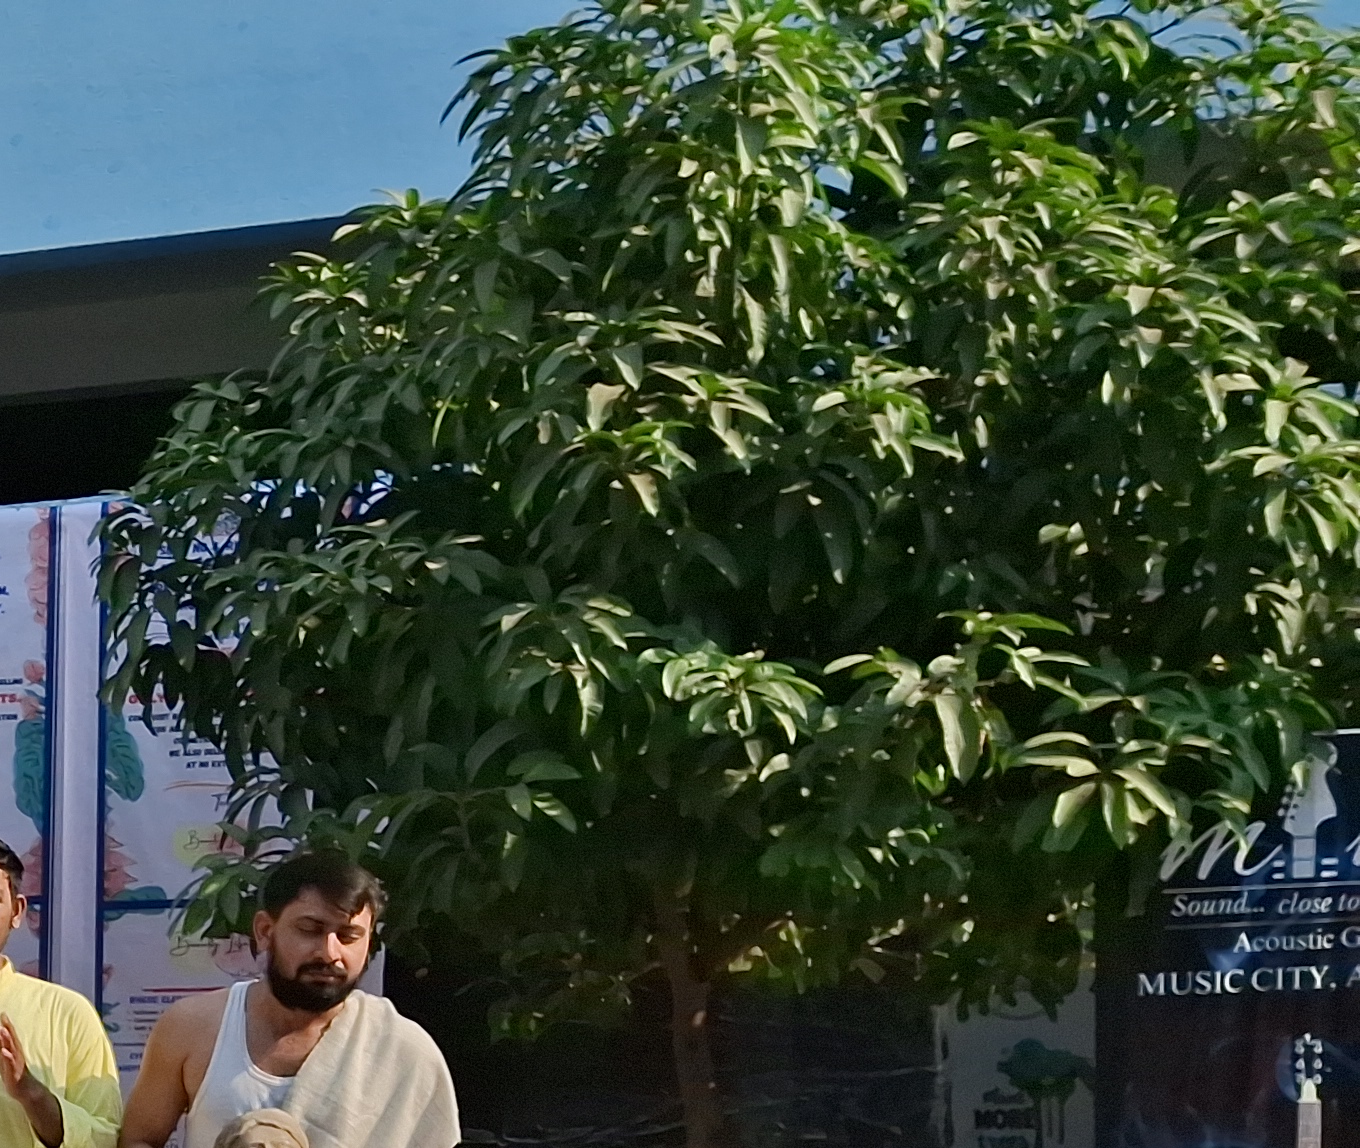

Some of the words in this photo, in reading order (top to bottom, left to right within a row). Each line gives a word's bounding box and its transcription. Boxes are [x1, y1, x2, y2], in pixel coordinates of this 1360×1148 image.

[1277, 891, 1332, 914] close
[1233, 927, 1335, 953] Acoustic
[1137, 967, 1245, 997] MUSIC
